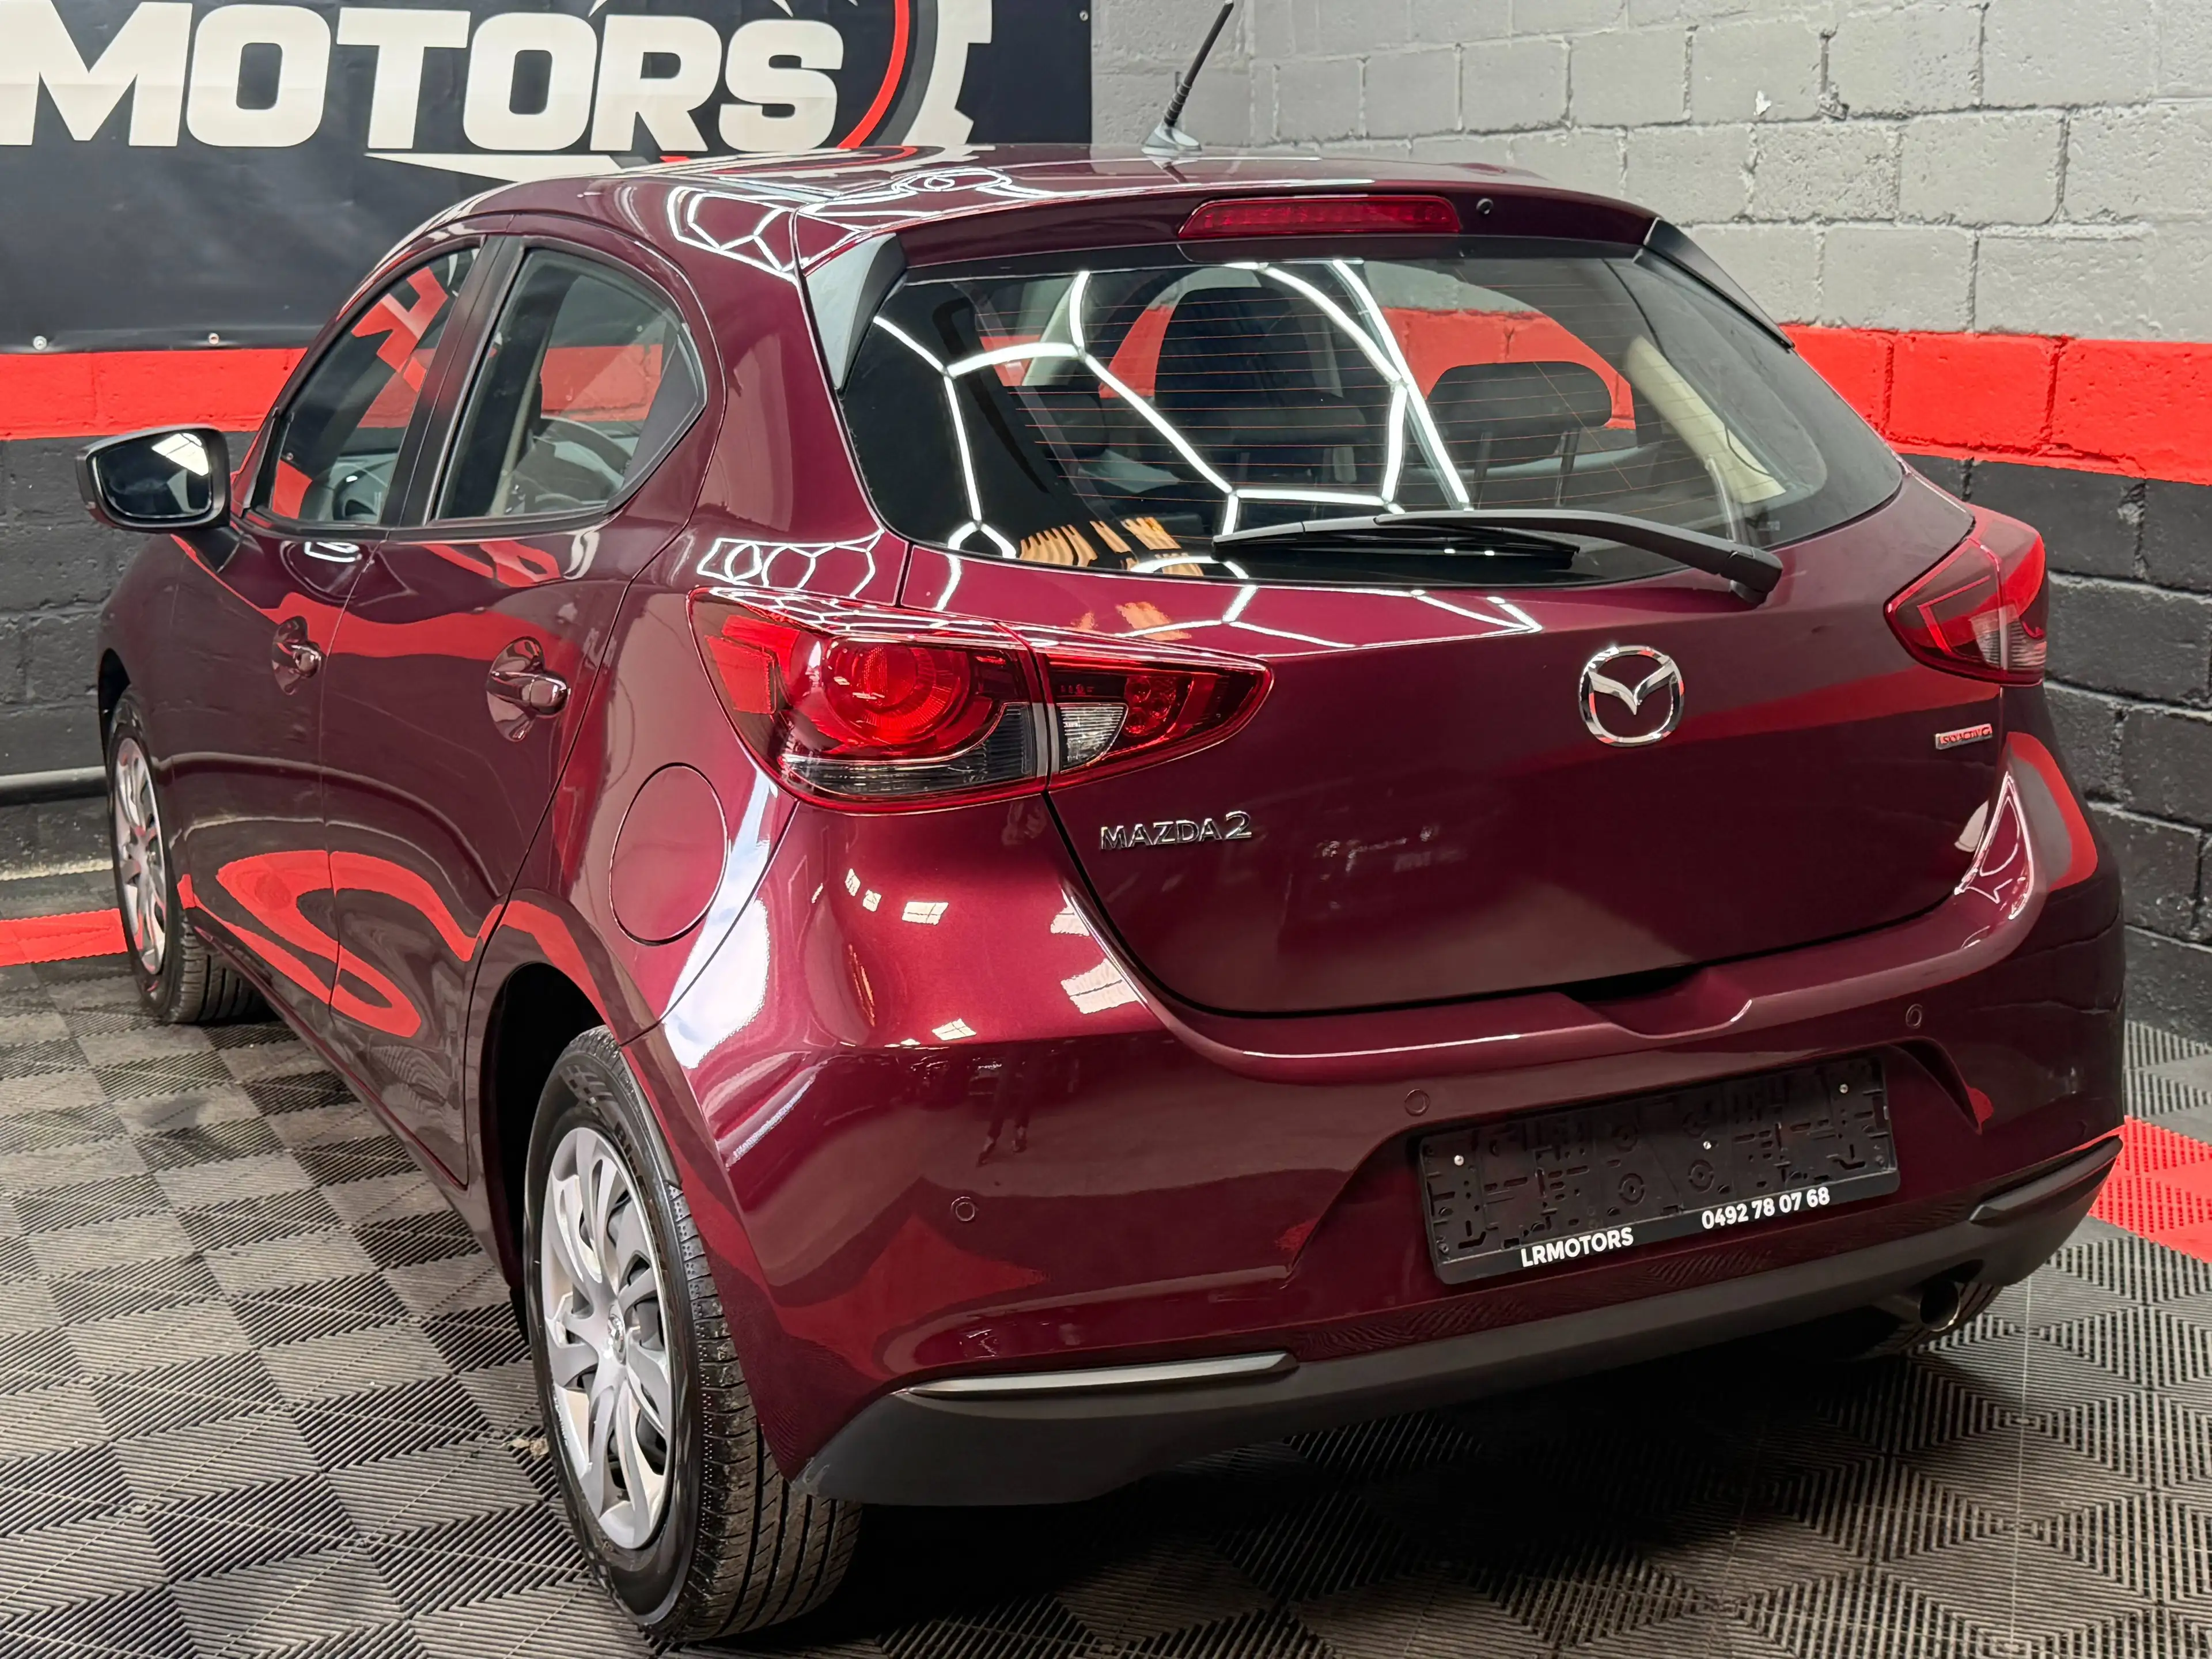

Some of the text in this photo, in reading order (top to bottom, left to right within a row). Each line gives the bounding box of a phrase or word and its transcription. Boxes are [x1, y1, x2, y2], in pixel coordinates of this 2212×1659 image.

[0, 0, 844, 151] MOTORS
[1521, 1187, 1830, 1267] LRMOTORS 0492 78 07 68
